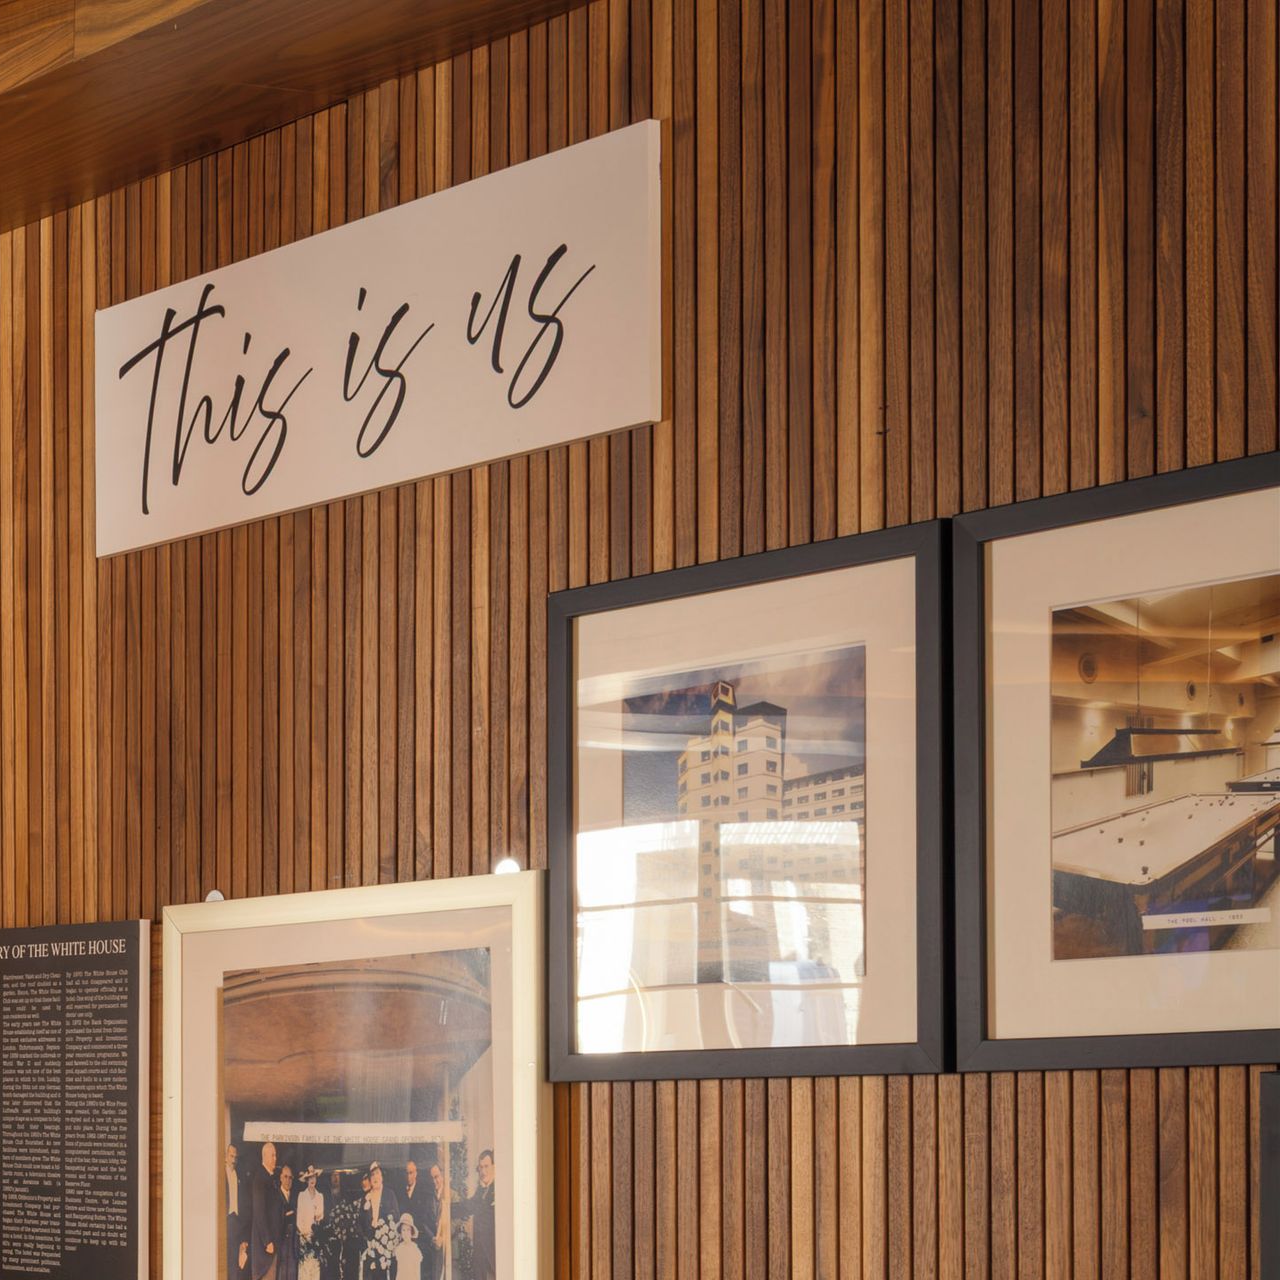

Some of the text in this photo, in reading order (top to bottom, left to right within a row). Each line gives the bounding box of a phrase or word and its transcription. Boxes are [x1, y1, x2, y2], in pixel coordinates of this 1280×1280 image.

[119, 243, 596, 515] This is us
[12, 944, 27, 959] OF
[28, 943, 50, 959] THE
[51, 940, 87, 957] WHITE
[88, 938, 127, 955] HOUSE
